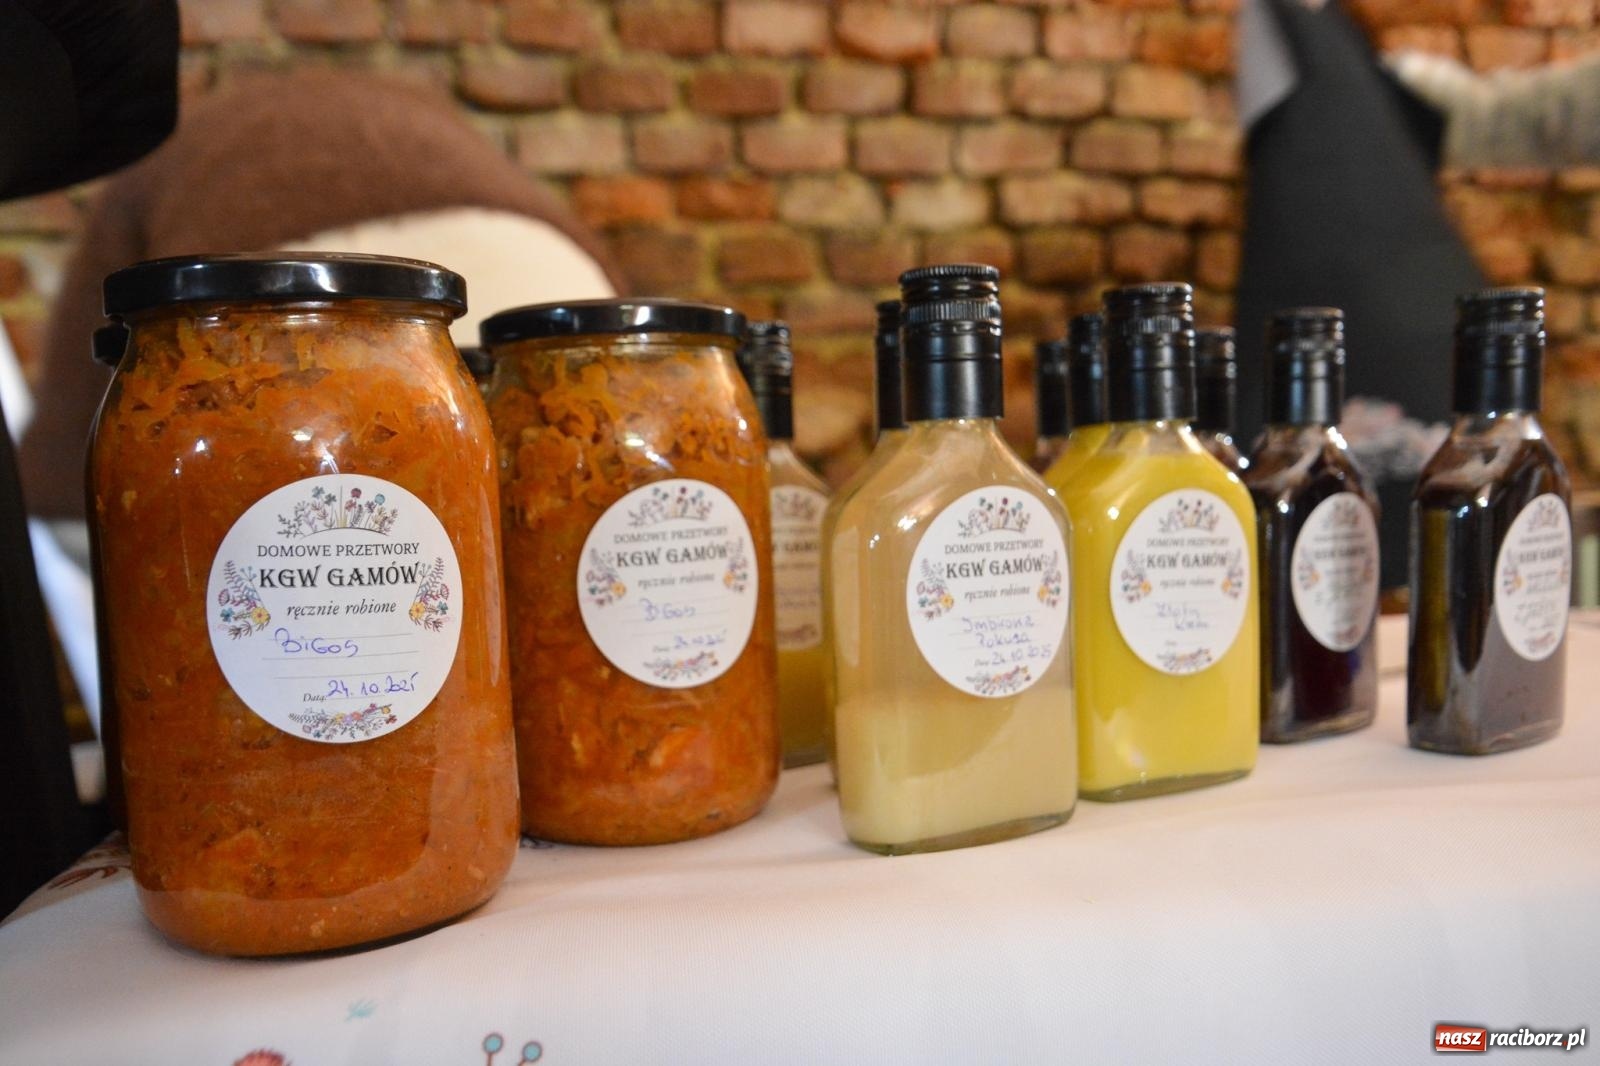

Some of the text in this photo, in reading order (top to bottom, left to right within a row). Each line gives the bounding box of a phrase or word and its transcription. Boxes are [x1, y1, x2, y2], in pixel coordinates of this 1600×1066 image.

[613, 526, 728, 544] DOMOWE PRZETWORY
[257, 542, 420, 557] DOMOWE PRZETWORY
[616, 541, 729, 568] KGW GAMÓW
[944, 538, 1044, 555] DOMOWE PRZETWORY
[946, 554, 1045, 579] KGW GAMÓW
[1146, 550, 1228, 568] KGW GAMÓW
[259, 560, 420, 588] KGW GAMÓW
[287, 598, 397, 621] ręcznie robione
